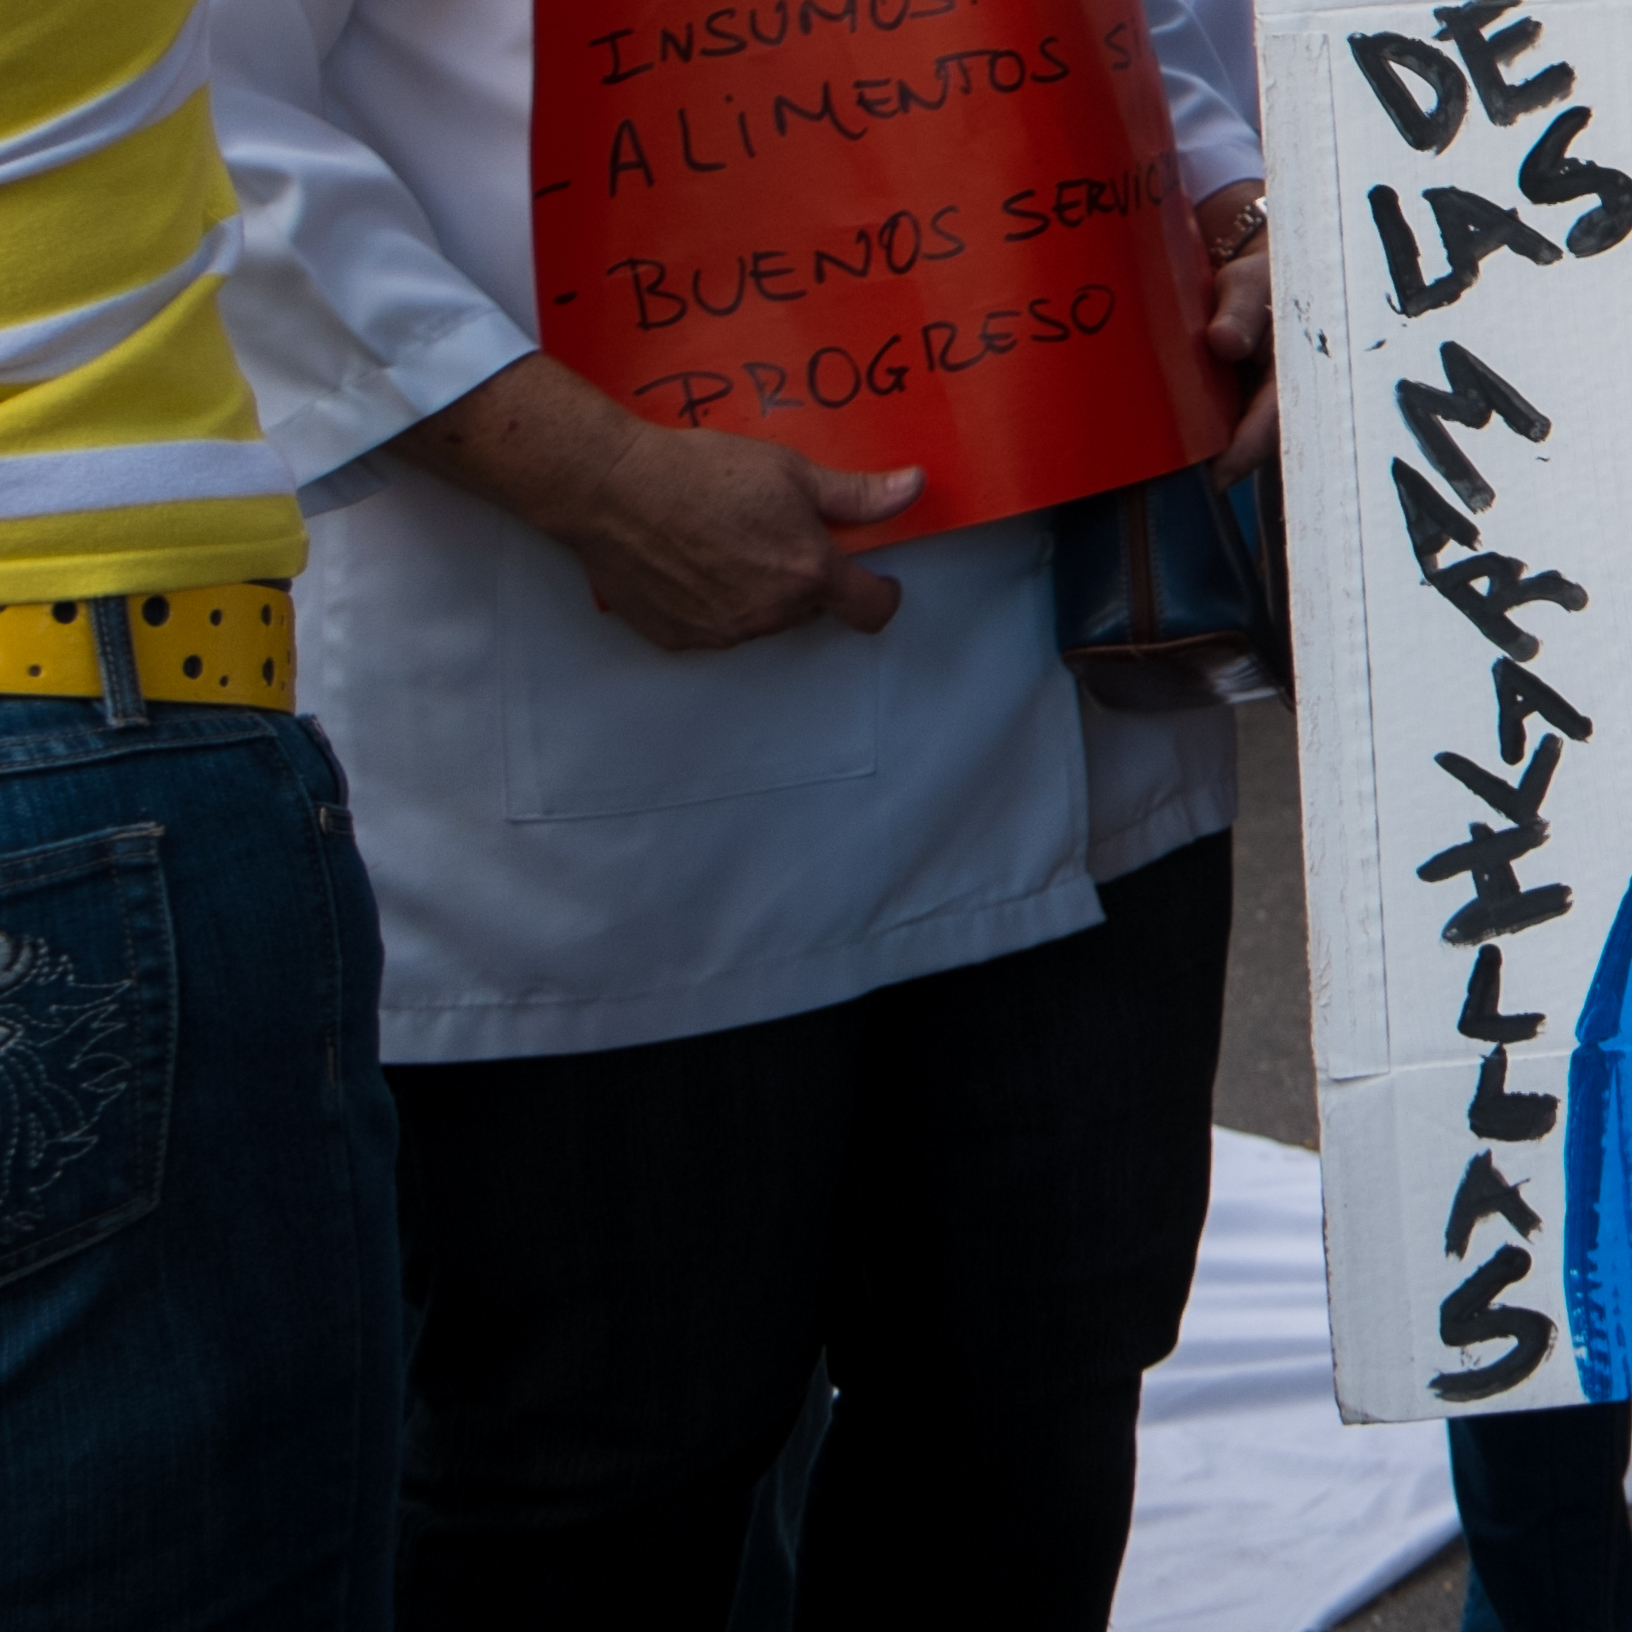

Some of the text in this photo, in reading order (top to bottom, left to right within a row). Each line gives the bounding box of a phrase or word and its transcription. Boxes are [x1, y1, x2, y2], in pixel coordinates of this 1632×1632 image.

[607, 205, 966, 331] BUENOS
[634, 285, 1117, 428] PROGRESO
[1391, 340, 1593, 1402] MARAVILLAS
